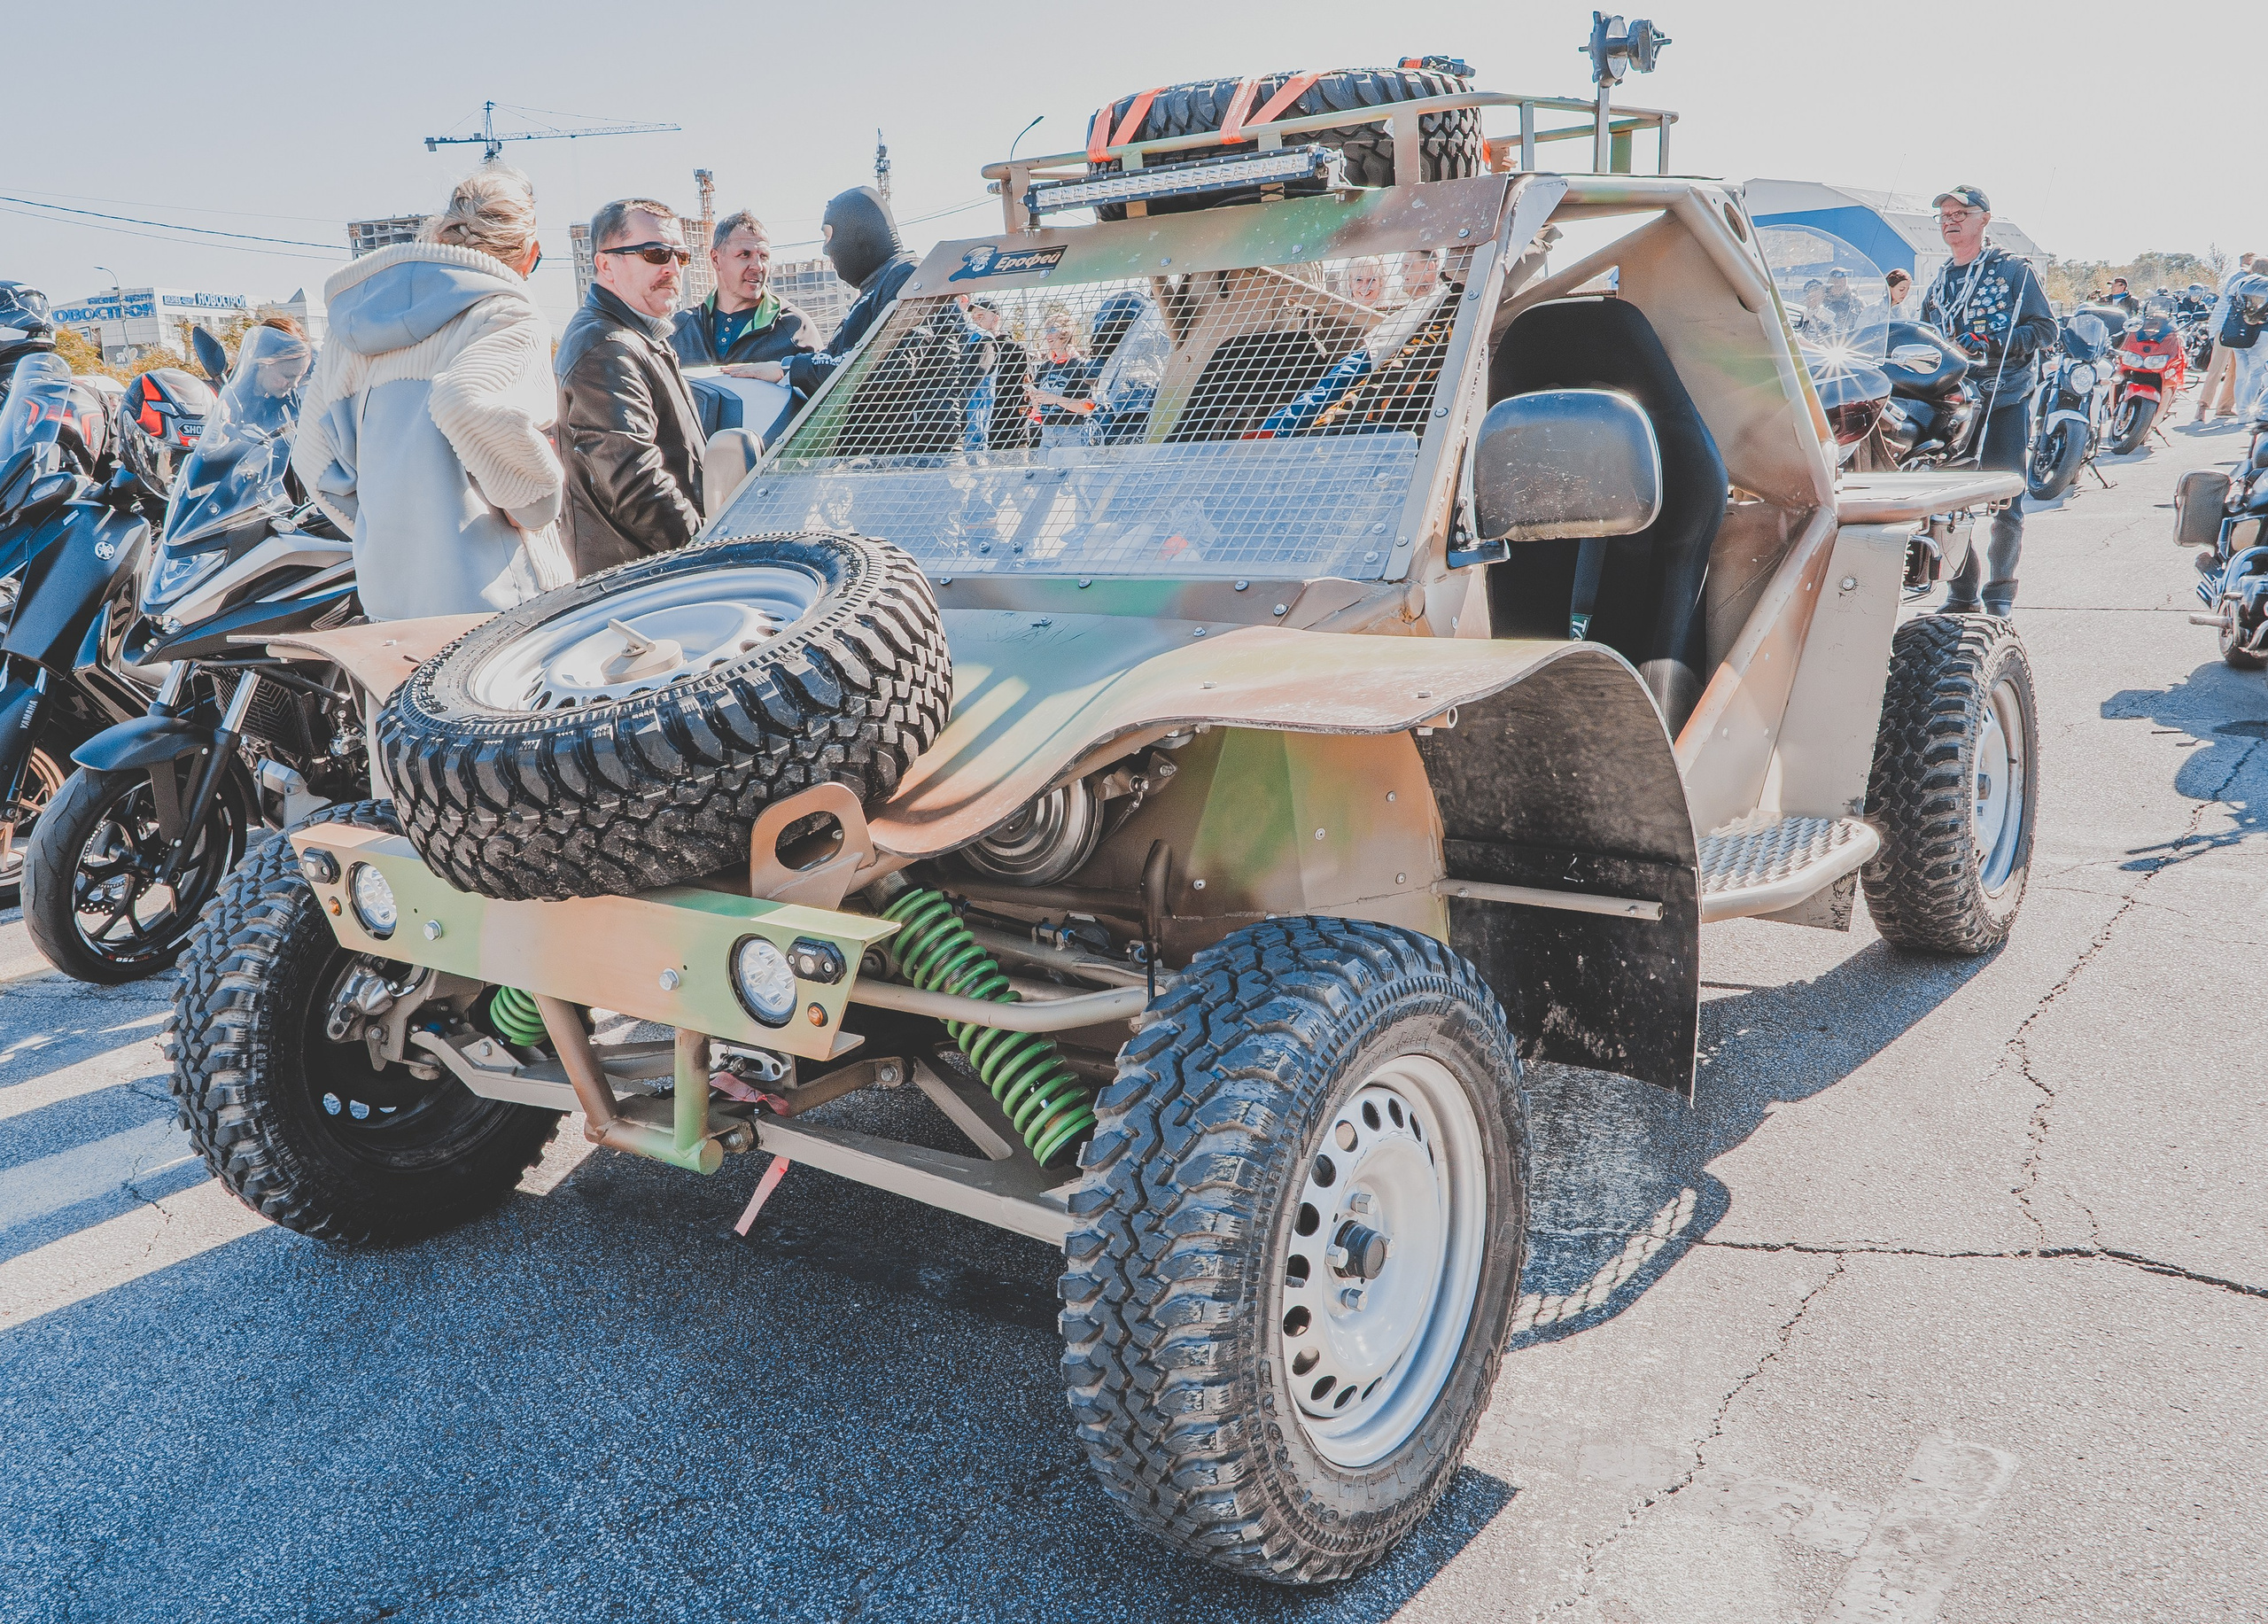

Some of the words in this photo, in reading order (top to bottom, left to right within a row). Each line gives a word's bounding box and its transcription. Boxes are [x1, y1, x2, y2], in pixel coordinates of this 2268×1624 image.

[994, 252, 1061, 271] Ерофей
[51, 302, 155, 323] ОВОСТРОЙ
[19, 700, 38, 729] YAMAHA
